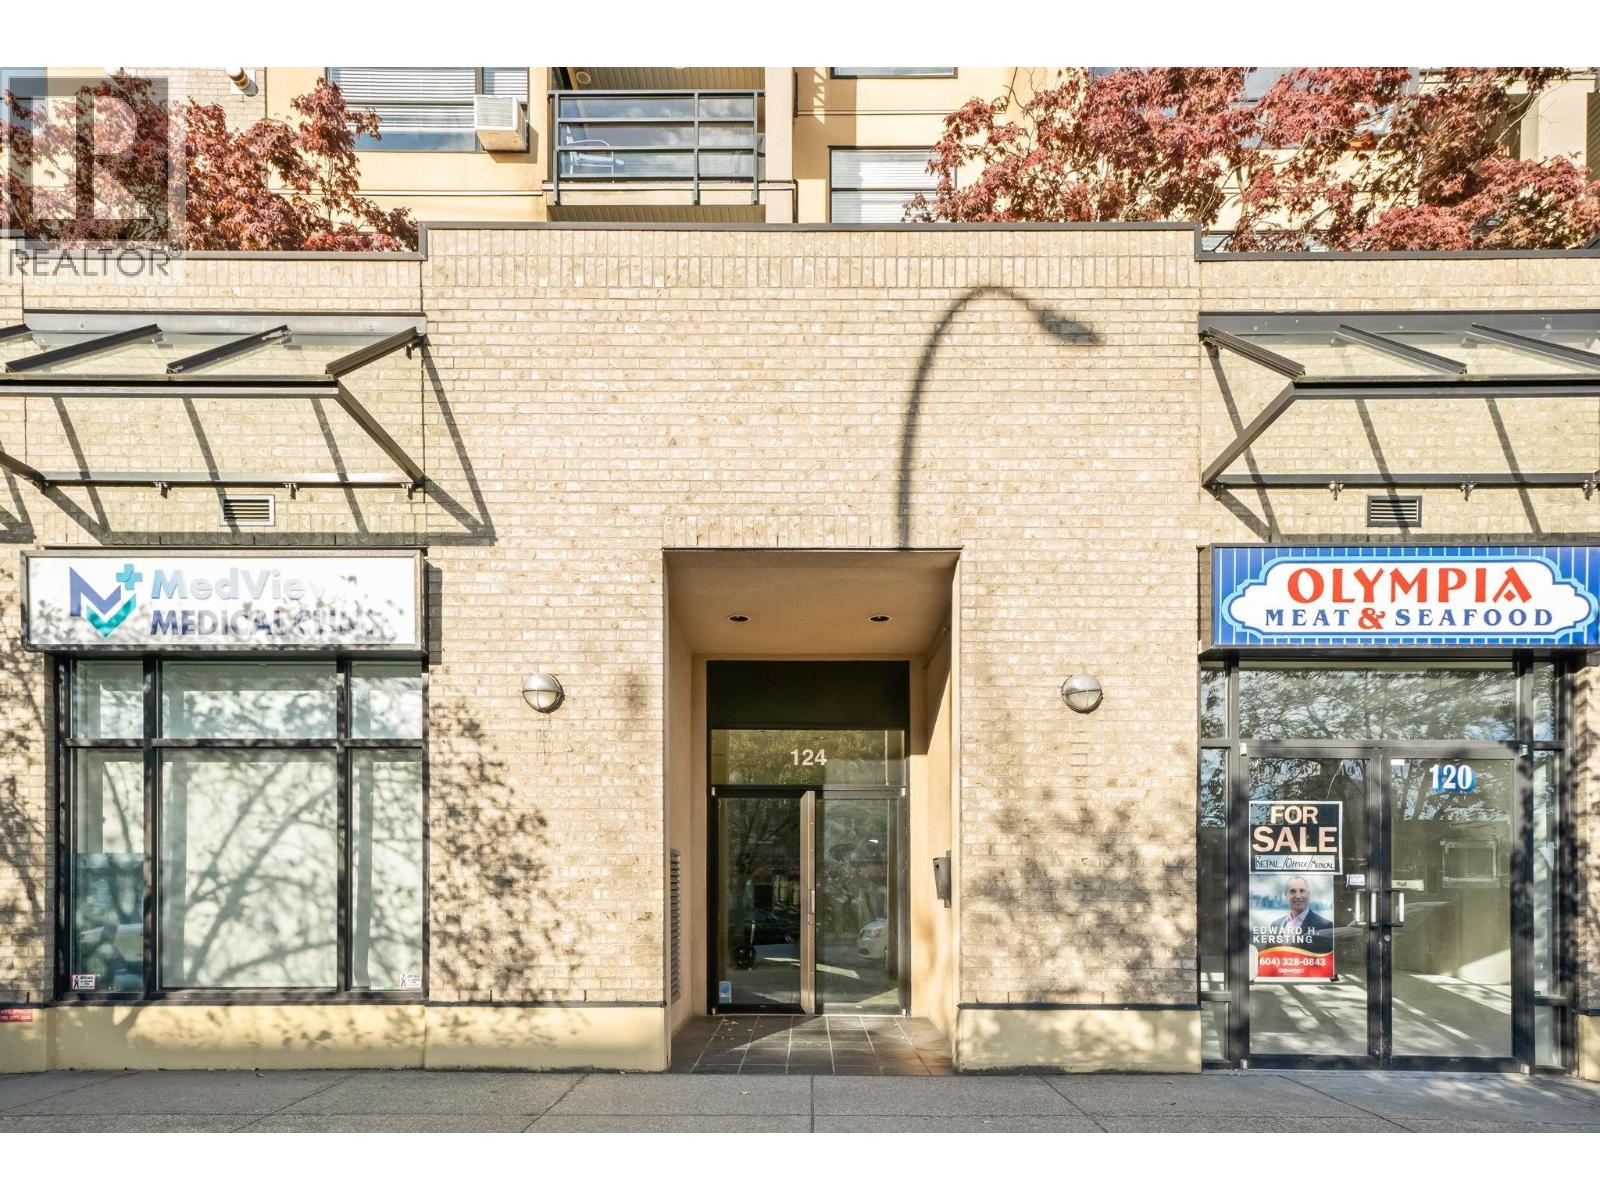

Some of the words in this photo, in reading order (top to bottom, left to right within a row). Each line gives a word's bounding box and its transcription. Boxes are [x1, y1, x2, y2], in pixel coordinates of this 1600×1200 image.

[1287, 566, 1533, 604] OLYMPIA
[150, 609, 286, 636] MEDICAL
[1265, 608, 1350, 627] MEAT
[1357, 607, 1387, 631] &
[1394, 608, 1553, 627] SEAFOOD
[790, 748, 828, 766] 124
[1429, 763, 1474, 790] 120
[1269, 805, 1319, 825] FOR
[1251, 826, 1338, 853] SALE
[1252, 926, 1303, 935] EDWARD
[1307, 926, 1320, 936] H.
[1252, 935, 1313, 944] KERSTING
[1282, 957, 1327, 967] 328-0843
